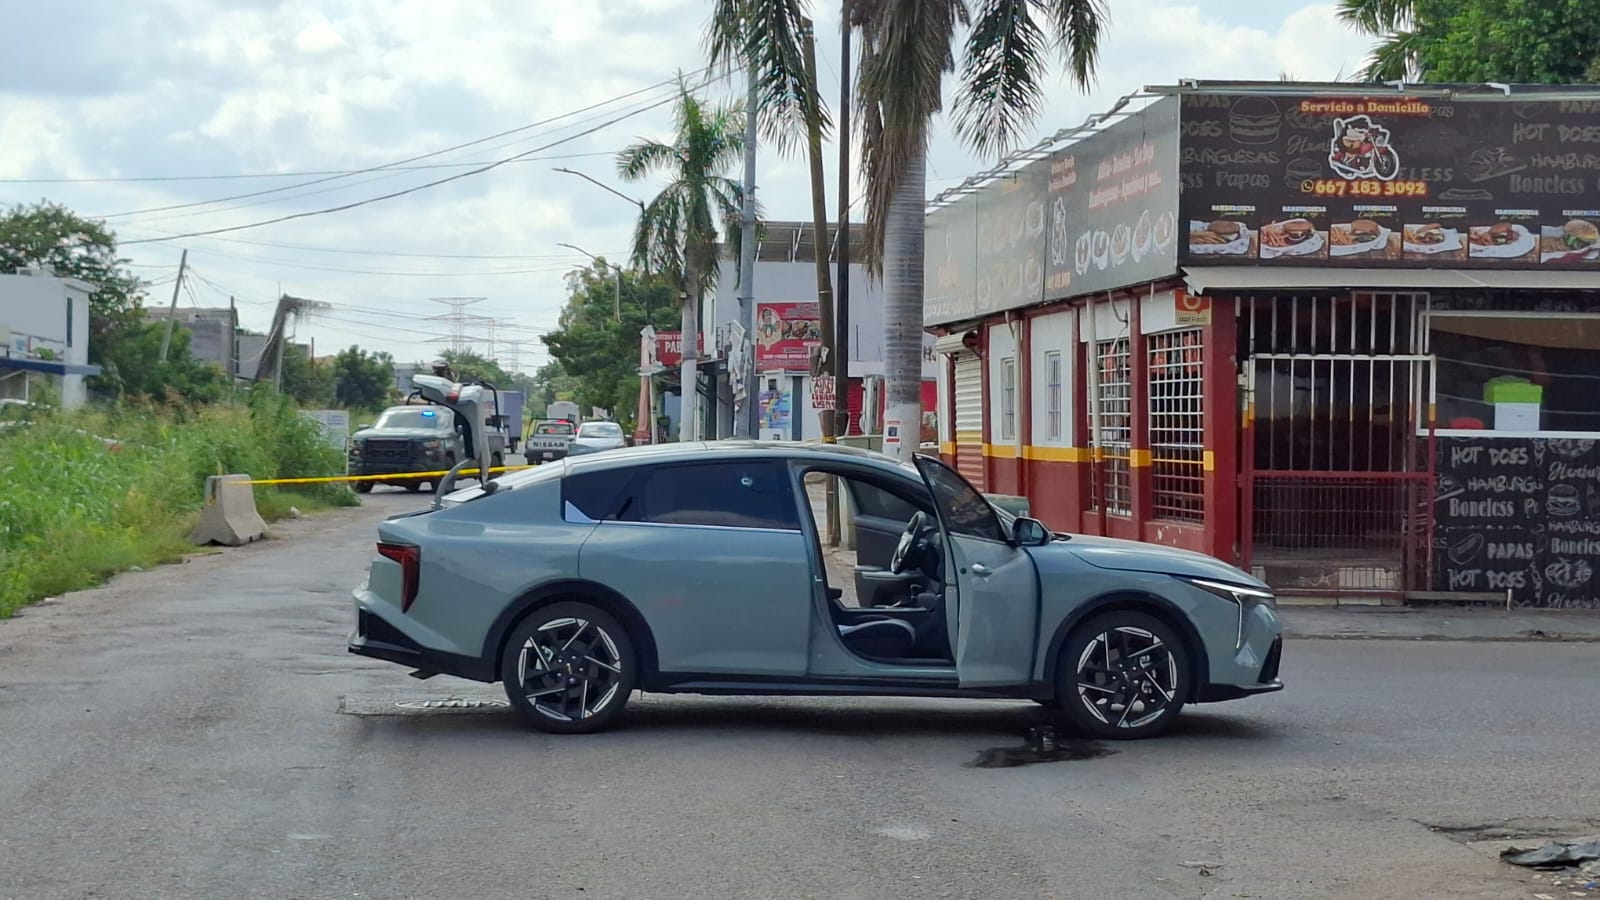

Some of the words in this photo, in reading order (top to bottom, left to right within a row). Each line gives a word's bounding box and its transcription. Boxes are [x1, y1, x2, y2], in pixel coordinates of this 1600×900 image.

[1301, 102, 1354, 112] Servicio
[1357, 104, 1365, 112] a
[1368, 102, 1429, 112] Domicilio
[1513, 123, 1549, 144] HOT
[1316, 181, 1345, 195] 667
[1351, 181, 1380, 195] 183
[1384, 182, 1426, 195] 3092
[1510, 175, 1585, 193] Boneless
[1451, 446, 1484, 468] HOT
[1450, 498, 1515, 517] Boneless
[1487, 543, 1533, 559] PAPAS
[1447, 568, 1481, 590] HOT
